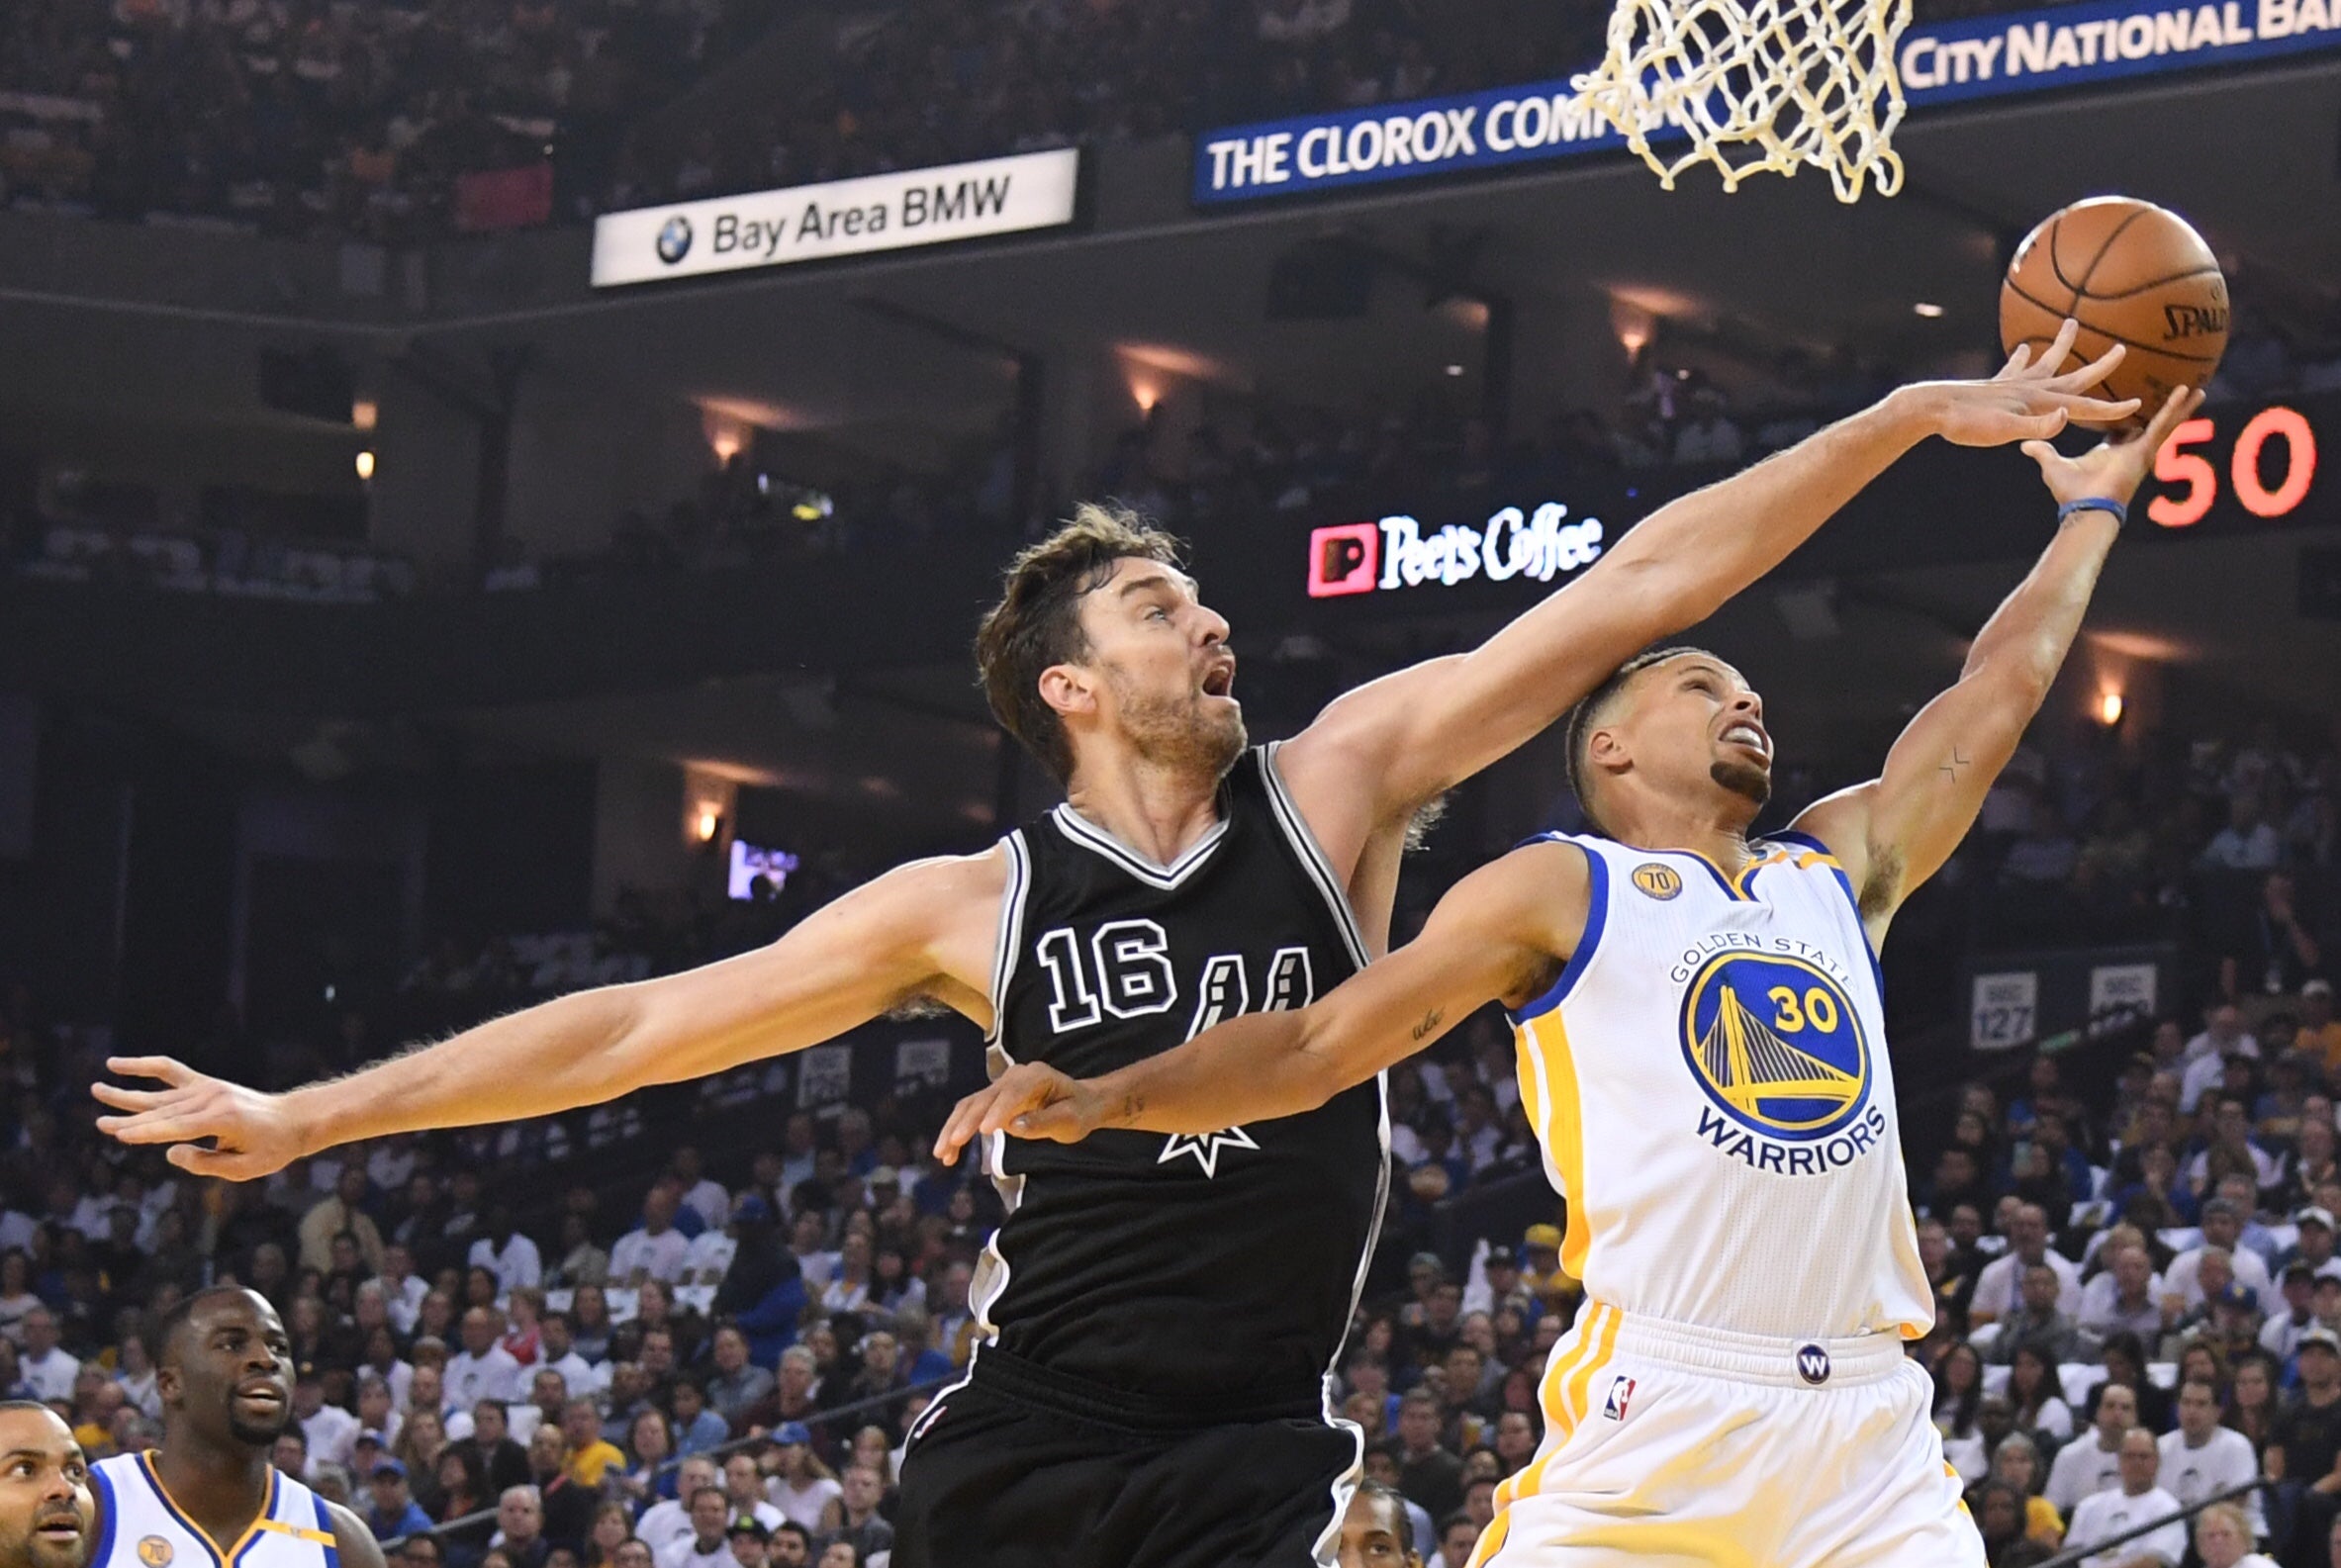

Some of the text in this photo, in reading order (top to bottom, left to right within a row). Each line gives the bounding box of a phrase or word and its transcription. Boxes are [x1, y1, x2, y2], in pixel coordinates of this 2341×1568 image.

[1900, 0, 2341, 90] CITY NATIONAL BA
[1206, 132, 1293, 191] THE
[1297, 106, 1478, 179] CLOROX
[712, 174, 1011, 257] Bay Area BMW
[2147, 407, 2317, 528] 50
[1482, 502, 1604, 582] Coffee
[1642, 872, 1670, 889] 70
[1036, 918, 1178, 1034] 16
[1670, 933, 1856, 992] GOLDEN STATE
[1767, 985, 1839, 1034] 30
[1977, 1006, 2033, 1038] 127
[1695, 1104, 1887, 1176] WARRIORS
[1802, 1354, 1826, 1376] W
